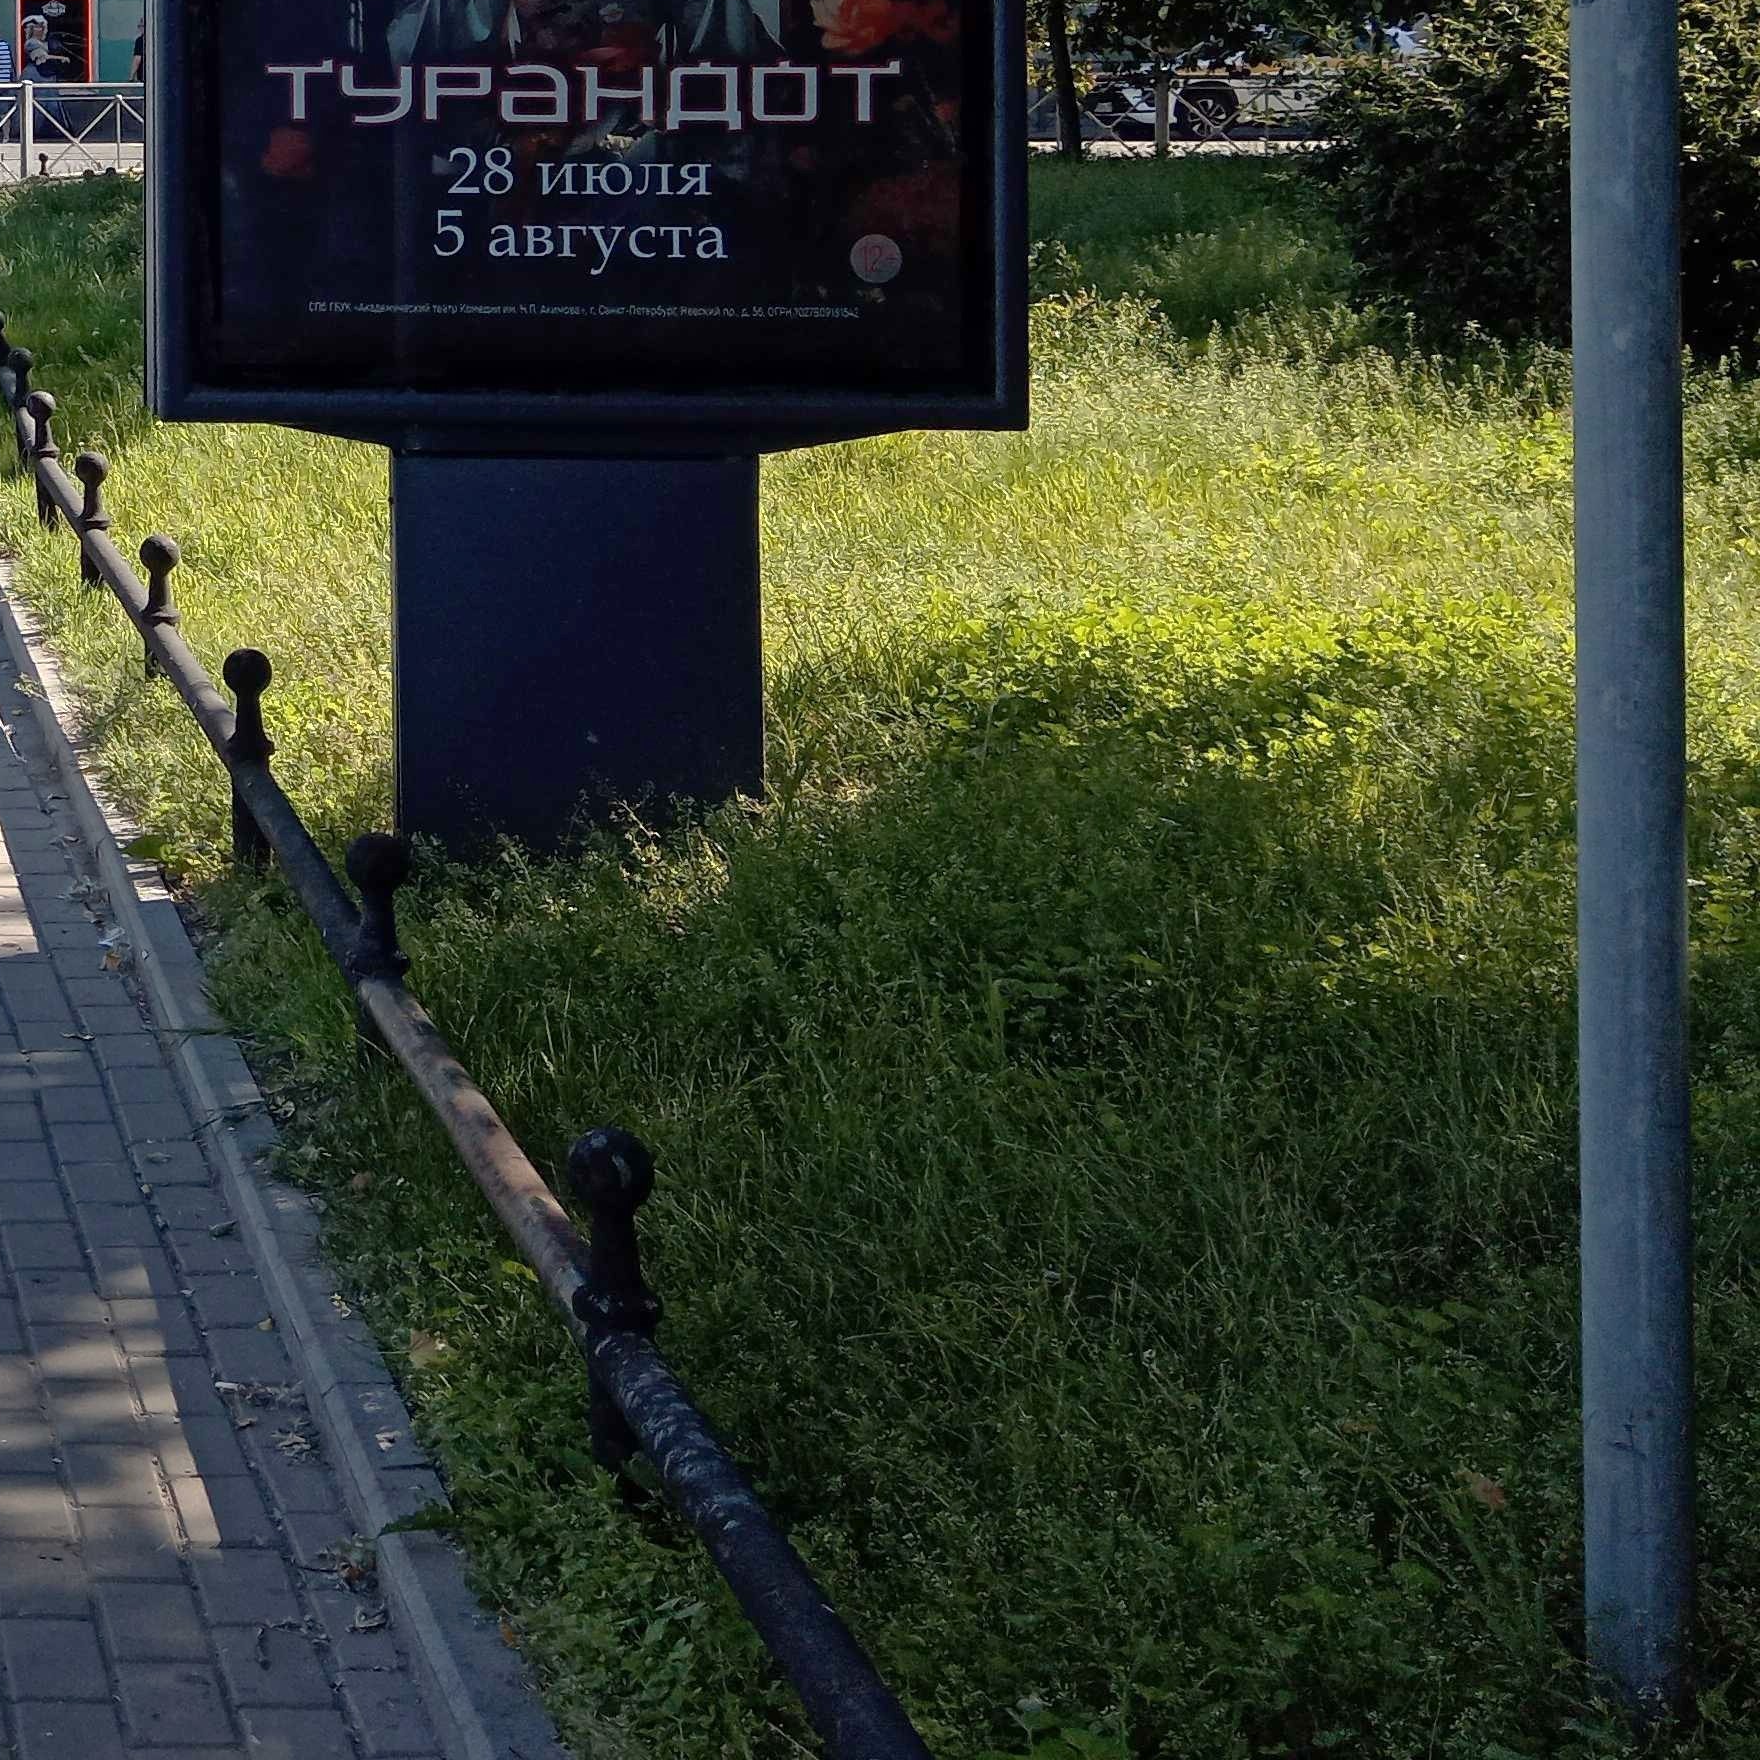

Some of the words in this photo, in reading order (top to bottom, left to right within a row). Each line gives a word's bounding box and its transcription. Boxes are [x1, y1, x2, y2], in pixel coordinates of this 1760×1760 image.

[266, 58, 903, 132] ТУРАНДОТ
[447, 146, 515, 195] 28
[535, 161, 713, 196] июля
[432, 208, 465, 257] 5
[487, 223, 729, 276] августа
